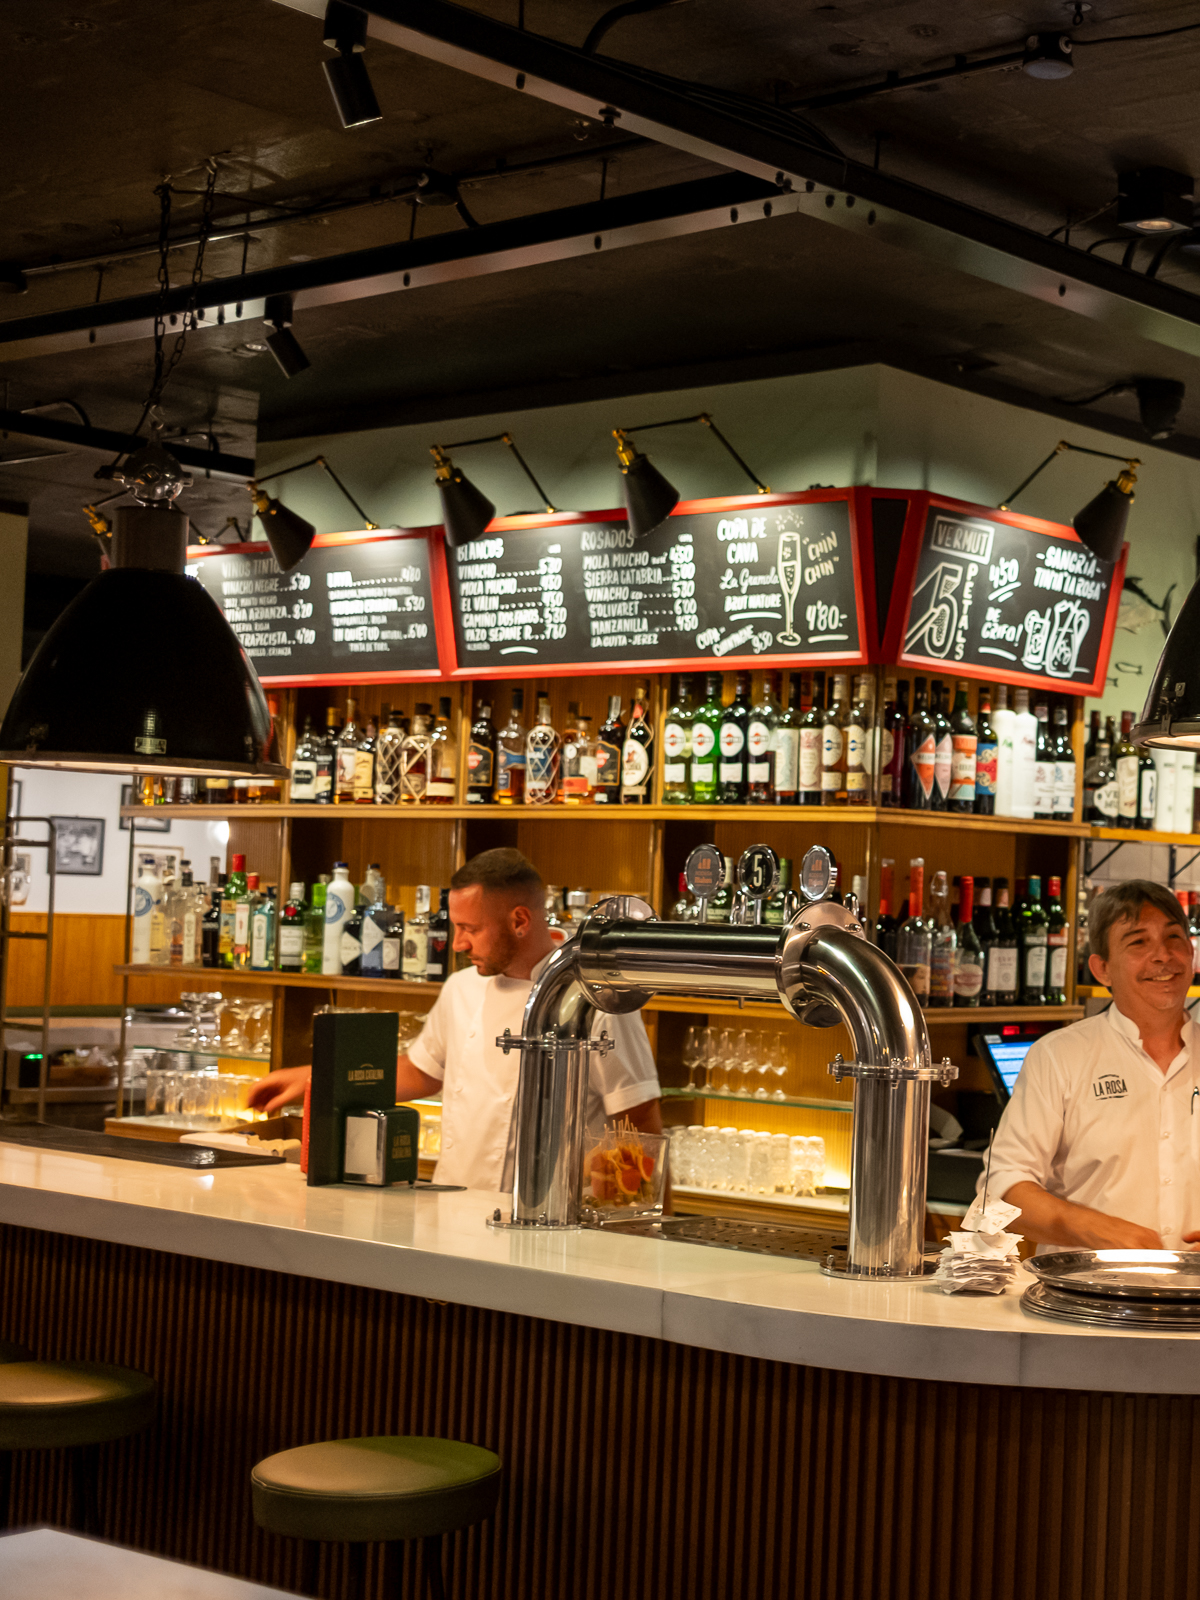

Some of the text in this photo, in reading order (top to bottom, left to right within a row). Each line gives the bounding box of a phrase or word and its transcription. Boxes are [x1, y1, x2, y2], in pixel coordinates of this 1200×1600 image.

[751, 517, 767, 539] DE
[581, 529, 635, 551] ROSADOS
[937, 523, 989, 557] VERMUT
[457, 538, 504, 562] BLANCOS
[726, 542, 759, 564] CAVA
[222, 561, 251, 578] VINOS
[254, 558, 285, 575] TINTO
[583, 553, 610, 570] MOLA
[612, 551, 650, 567] MUCHO
[458, 562, 497, 580] VINACHO
[583, 569, 620, 588] SIERRA
[222, 578, 279, 595] VINACHO NEGRE
[460, 578, 517, 596] MOLA MUCHO
[585, 586, 630, 602] VINACHO
[461, 596, 472, 612] EL
[724, 593, 782, 612] BRUT NATURE
[954, 563, 979, 660] PETALS
[225, 606, 287, 622] VIÑA ARDANZA
[986, 607, 1002, 622] DE
[465, 628, 487, 642] PAZO
[590, 617, 649, 636] MANZANILLA
[240, 631, 287, 647] TRAPECISTA
[590, 636, 602, 648] LA
[632, 633, 659, 645] JEREZ
[753, 854, 763, 888] 5
[1093, 1079, 1128, 1097] LA ROSA
